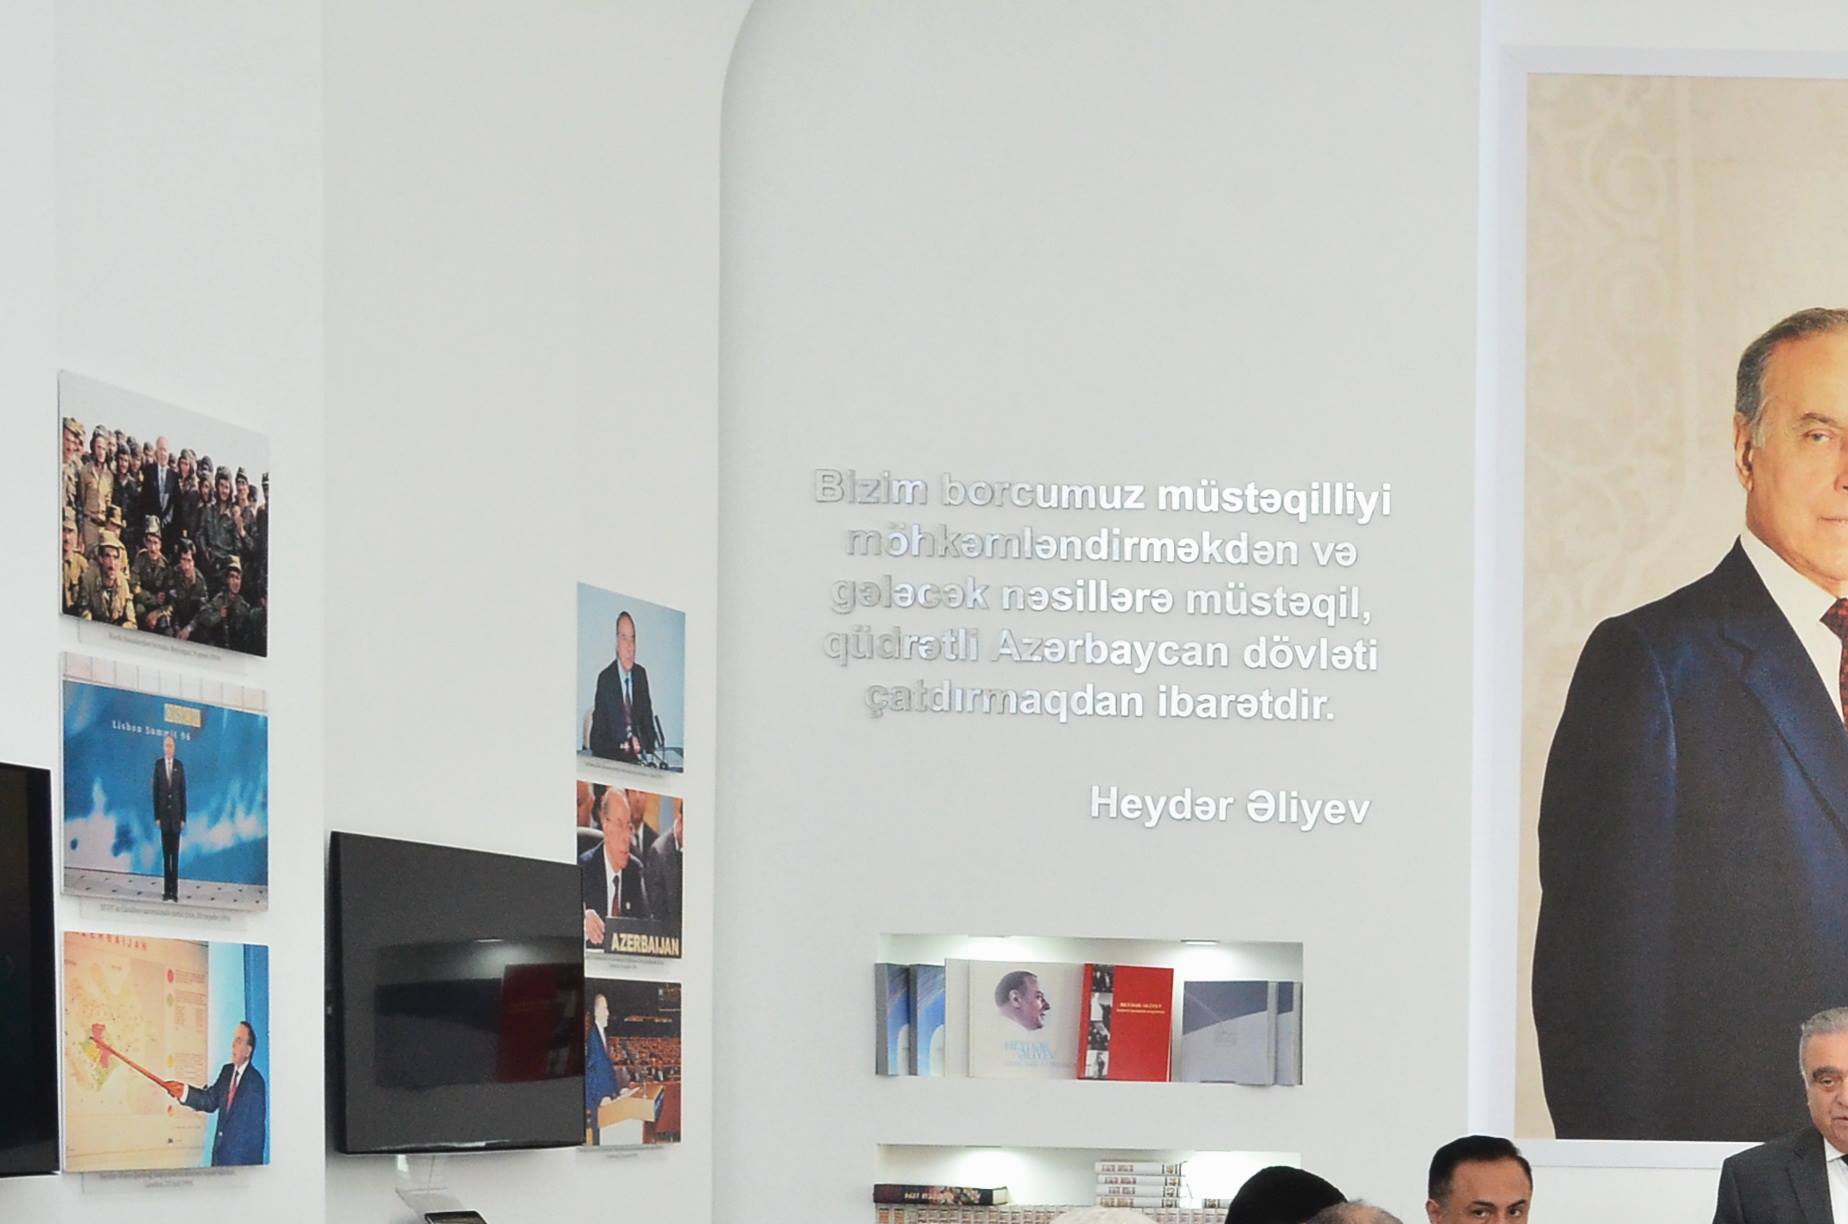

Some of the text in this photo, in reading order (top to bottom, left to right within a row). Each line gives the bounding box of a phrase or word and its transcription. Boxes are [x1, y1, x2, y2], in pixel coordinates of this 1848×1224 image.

[815, 469, 1392, 524] Bizim borcumuz müstəqilliyi
[847, 524, 1357, 566] möhkəmləndirməkdən və
[832, 575, 1372, 627] gələcək nəsillərə müstəqil,
[823, 625, 1379, 674] qüdrətli Azərbaycan dövləti
[864, 679, 1335, 724] çatdırmaqdan ibarətdir.
[112, 720, 142, 733] Lisbon
[1090, 786, 1370, 832] Heydər Əliyev
[611, 932, 681, 956] AZERBAIJAN
